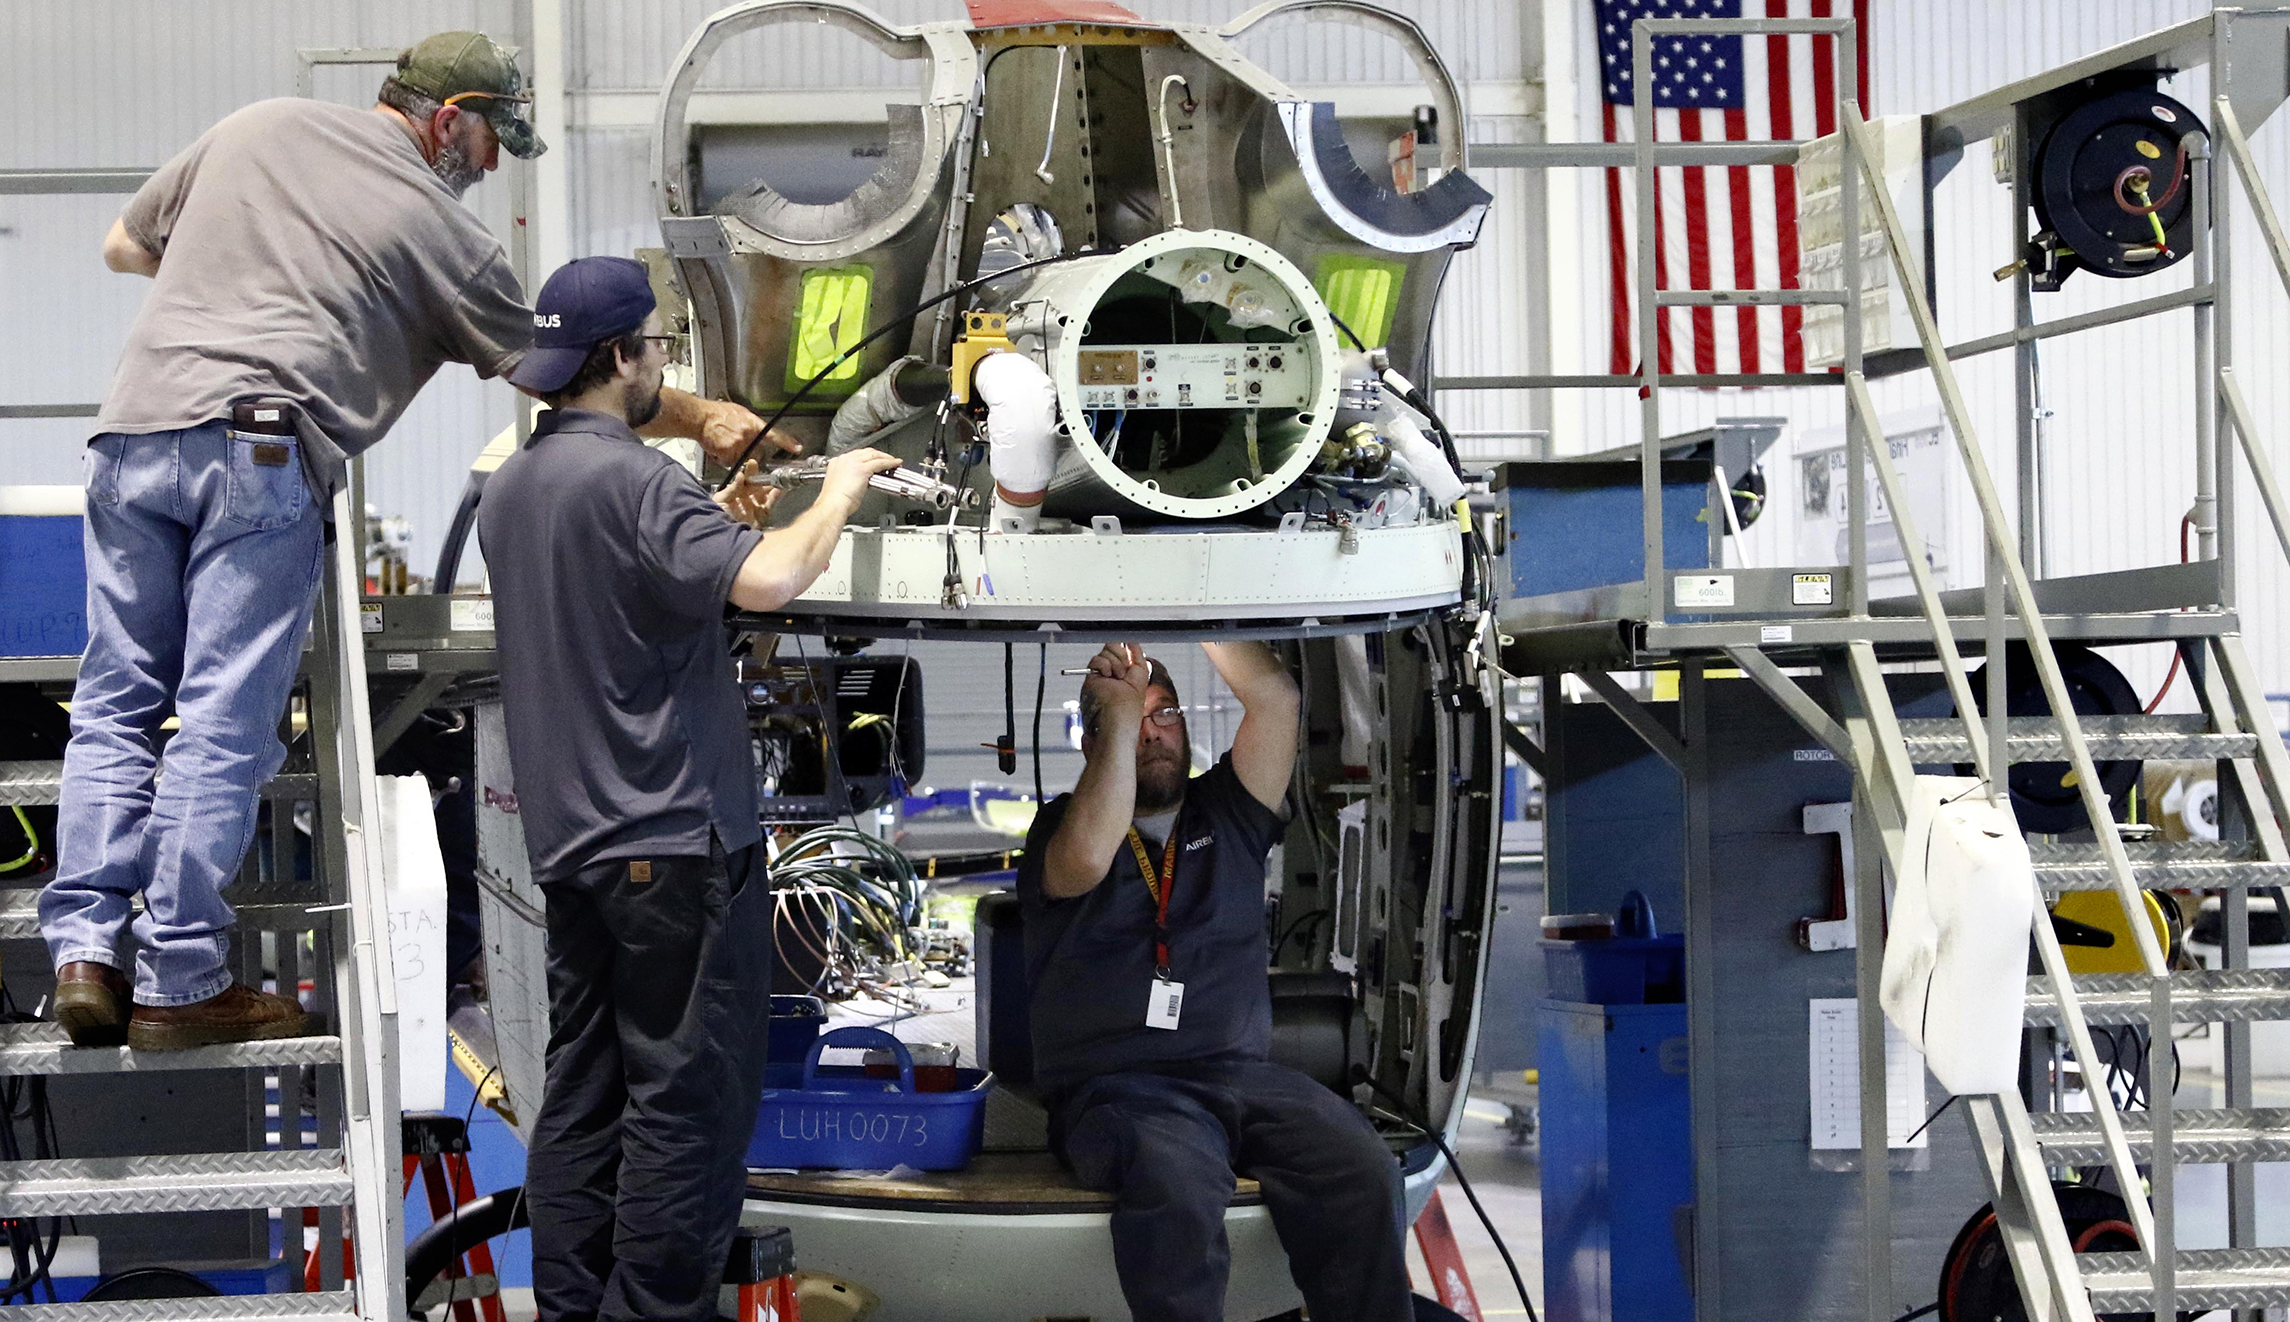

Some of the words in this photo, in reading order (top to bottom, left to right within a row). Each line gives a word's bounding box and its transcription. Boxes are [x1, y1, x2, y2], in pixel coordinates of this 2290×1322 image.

[533, 312, 561, 328] BUS
[1184, 829, 1214, 851] AIRB
[1164, 837, 1176, 879] MARIN
[398, 942, 425, 981] 3
